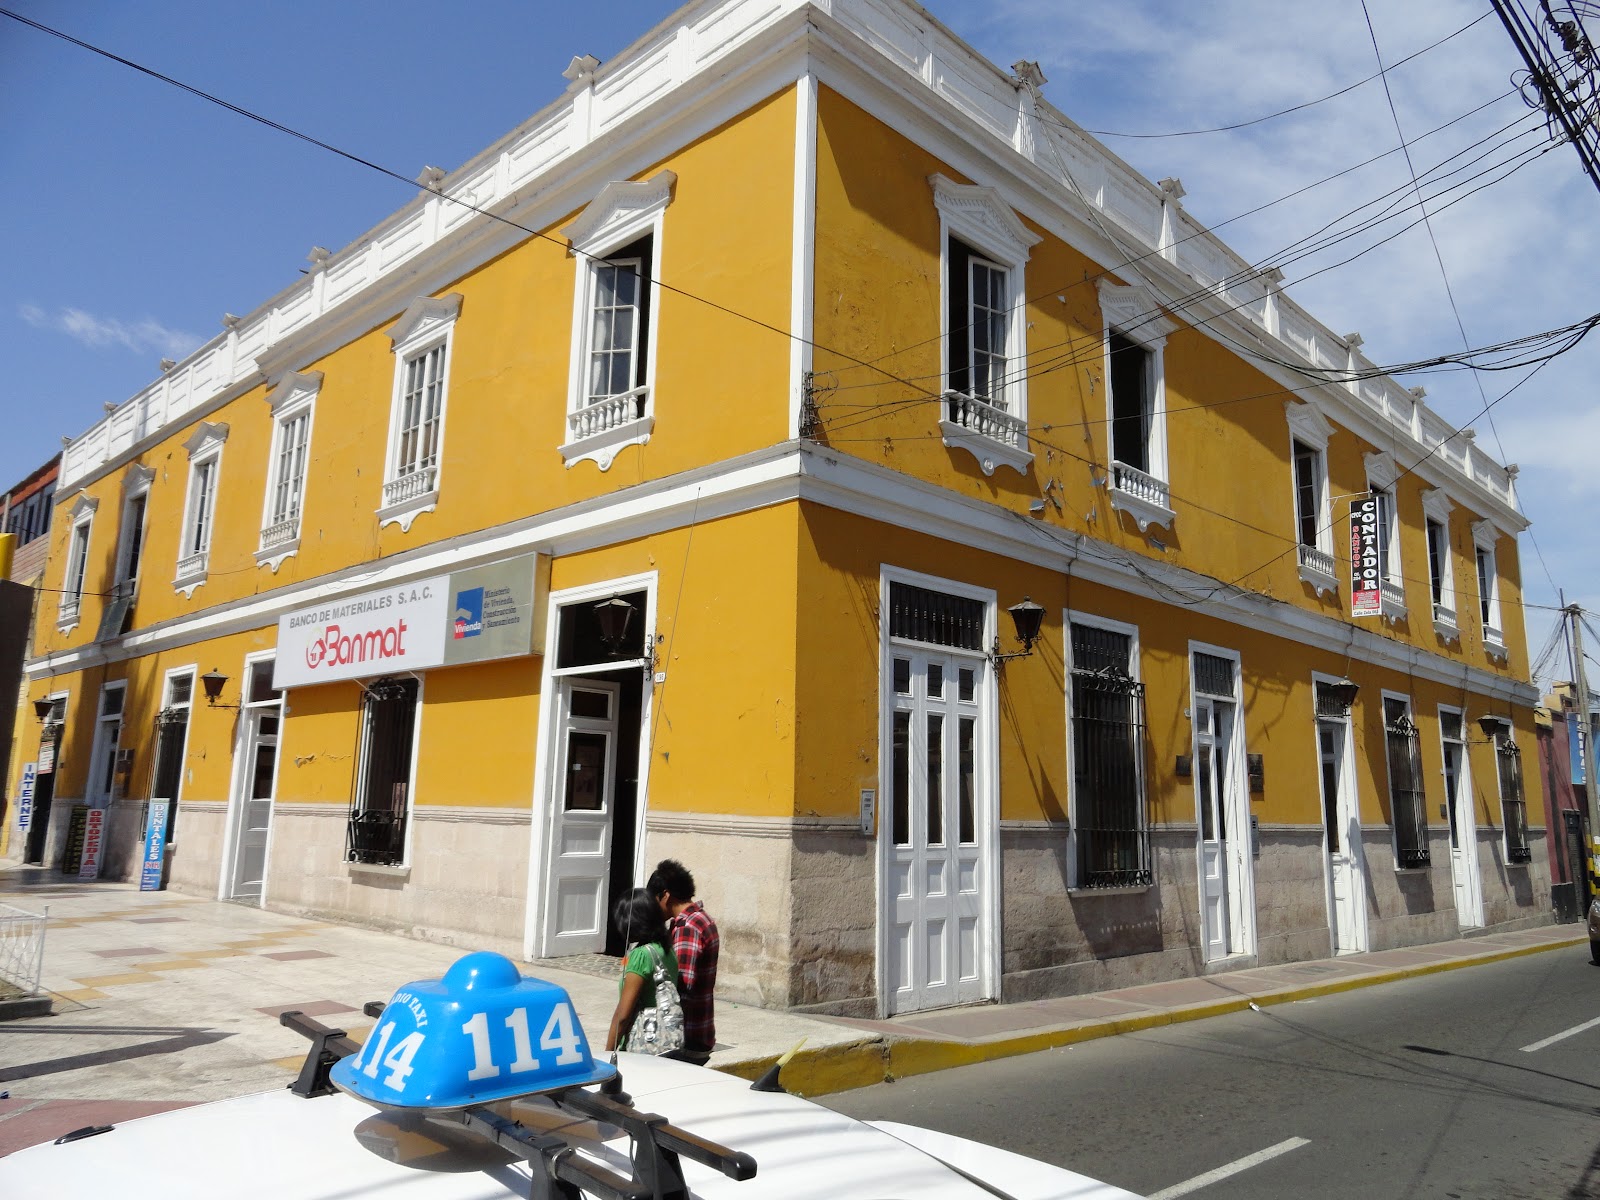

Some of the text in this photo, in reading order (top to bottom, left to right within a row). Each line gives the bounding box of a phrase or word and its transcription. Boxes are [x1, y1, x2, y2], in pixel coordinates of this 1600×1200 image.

[1352, 525, 1361, 568] SANTOS
[1361, 501, 1377, 590] CONTADOR
[289, 613, 318, 629] BANCO
[319, 610, 331, 623] DE
[332, 595, 392, 619] MATERIALES
[484, 587, 510, 598] Ministerio
[327, 618, 407, 667] Banmat
[455, 621, 481, 633] Vivienda
[19, 764, 34, 831] INTERNET
[84, 810, 102, 865] ORTOPEDIA
[149, 804, 164, 860] DENTALES
[408, 997, 428, 1028] TAXI
[461, 1002, 583, 1082] 114
